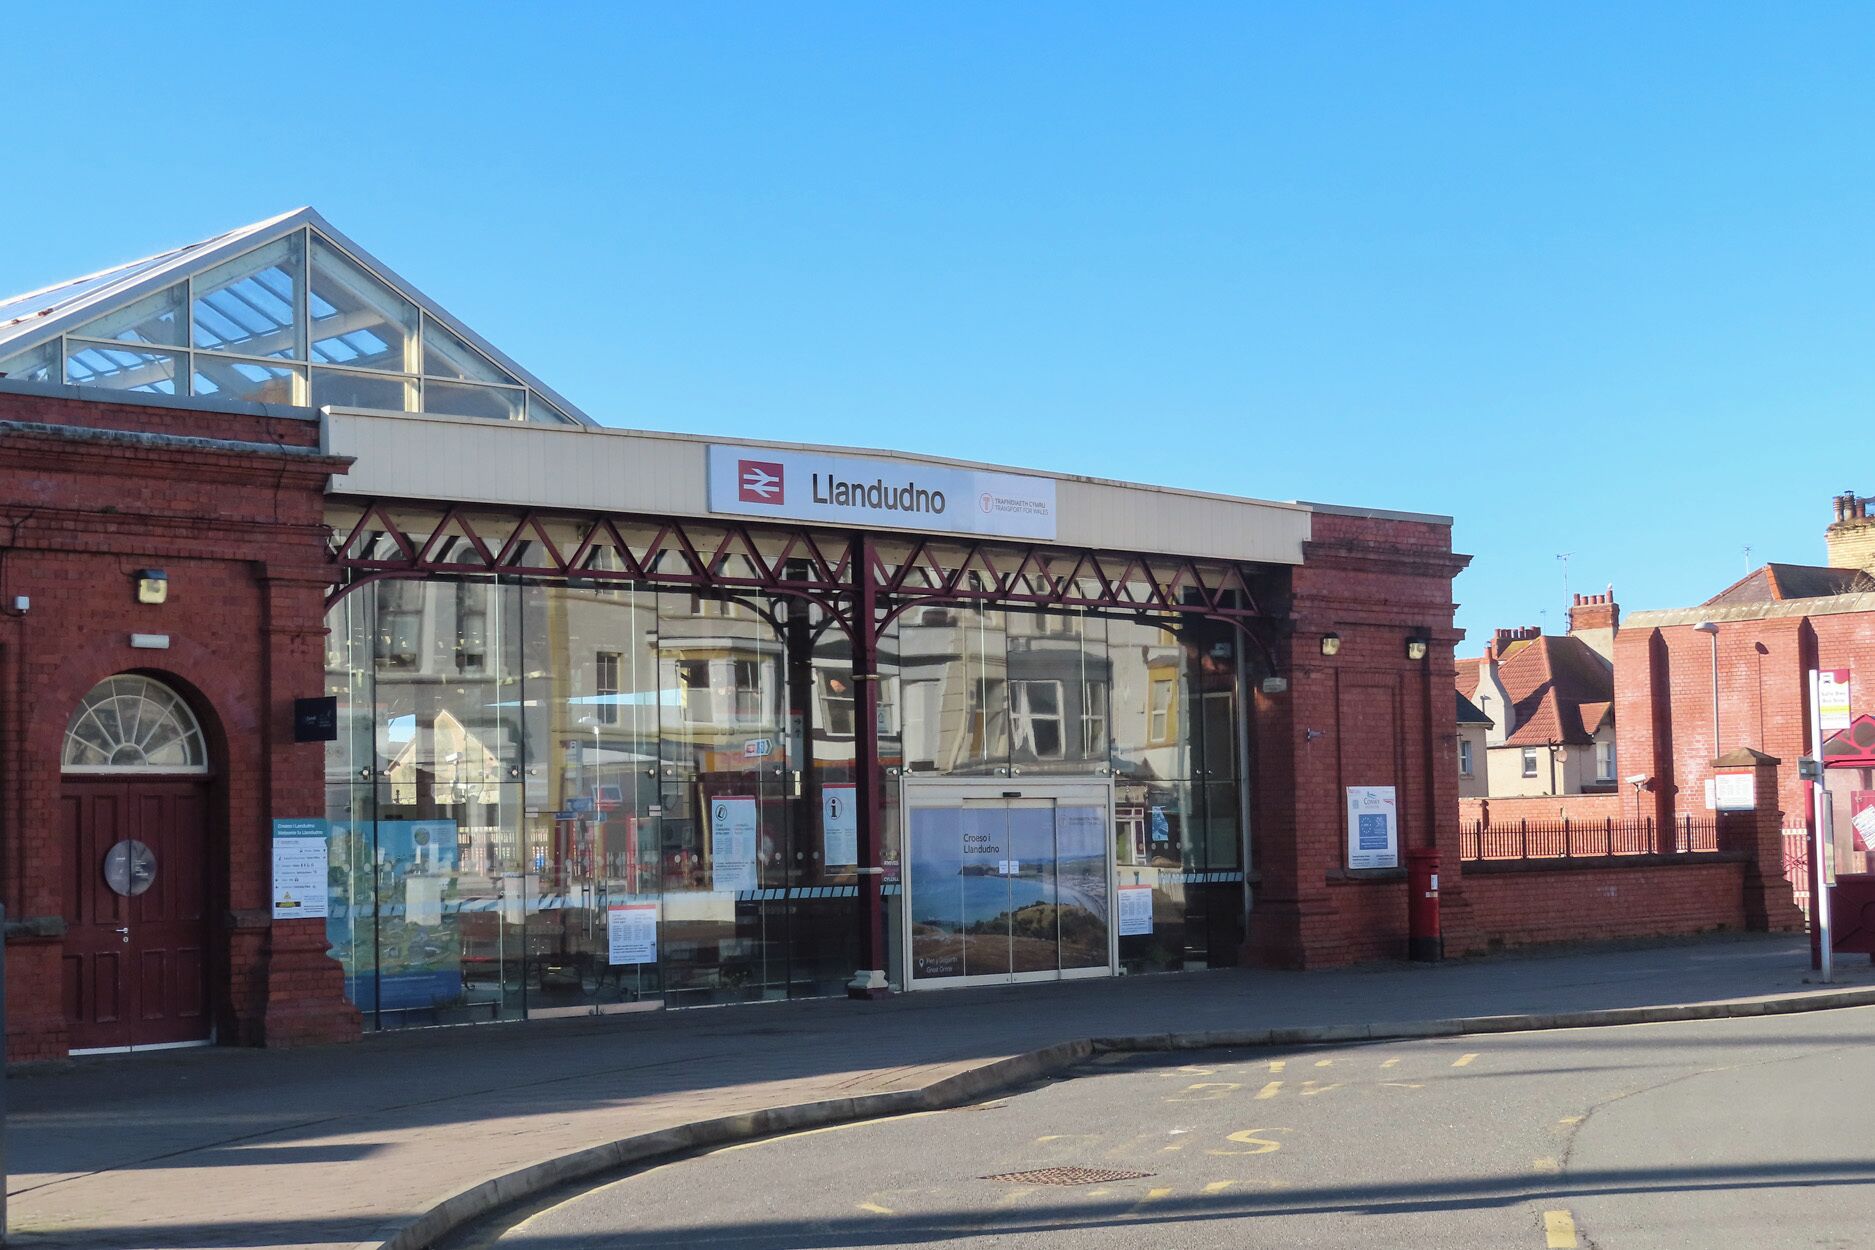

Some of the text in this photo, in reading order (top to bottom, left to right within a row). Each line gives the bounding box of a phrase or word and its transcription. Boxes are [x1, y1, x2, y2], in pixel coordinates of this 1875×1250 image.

[812, 473, 946, 515] Llandudno
[995, 498, 1028, 506] TRAFNIDIAETH
[963, 833, 987, 842] Croeso
[963, 844, 1000, 854] Llandudno
